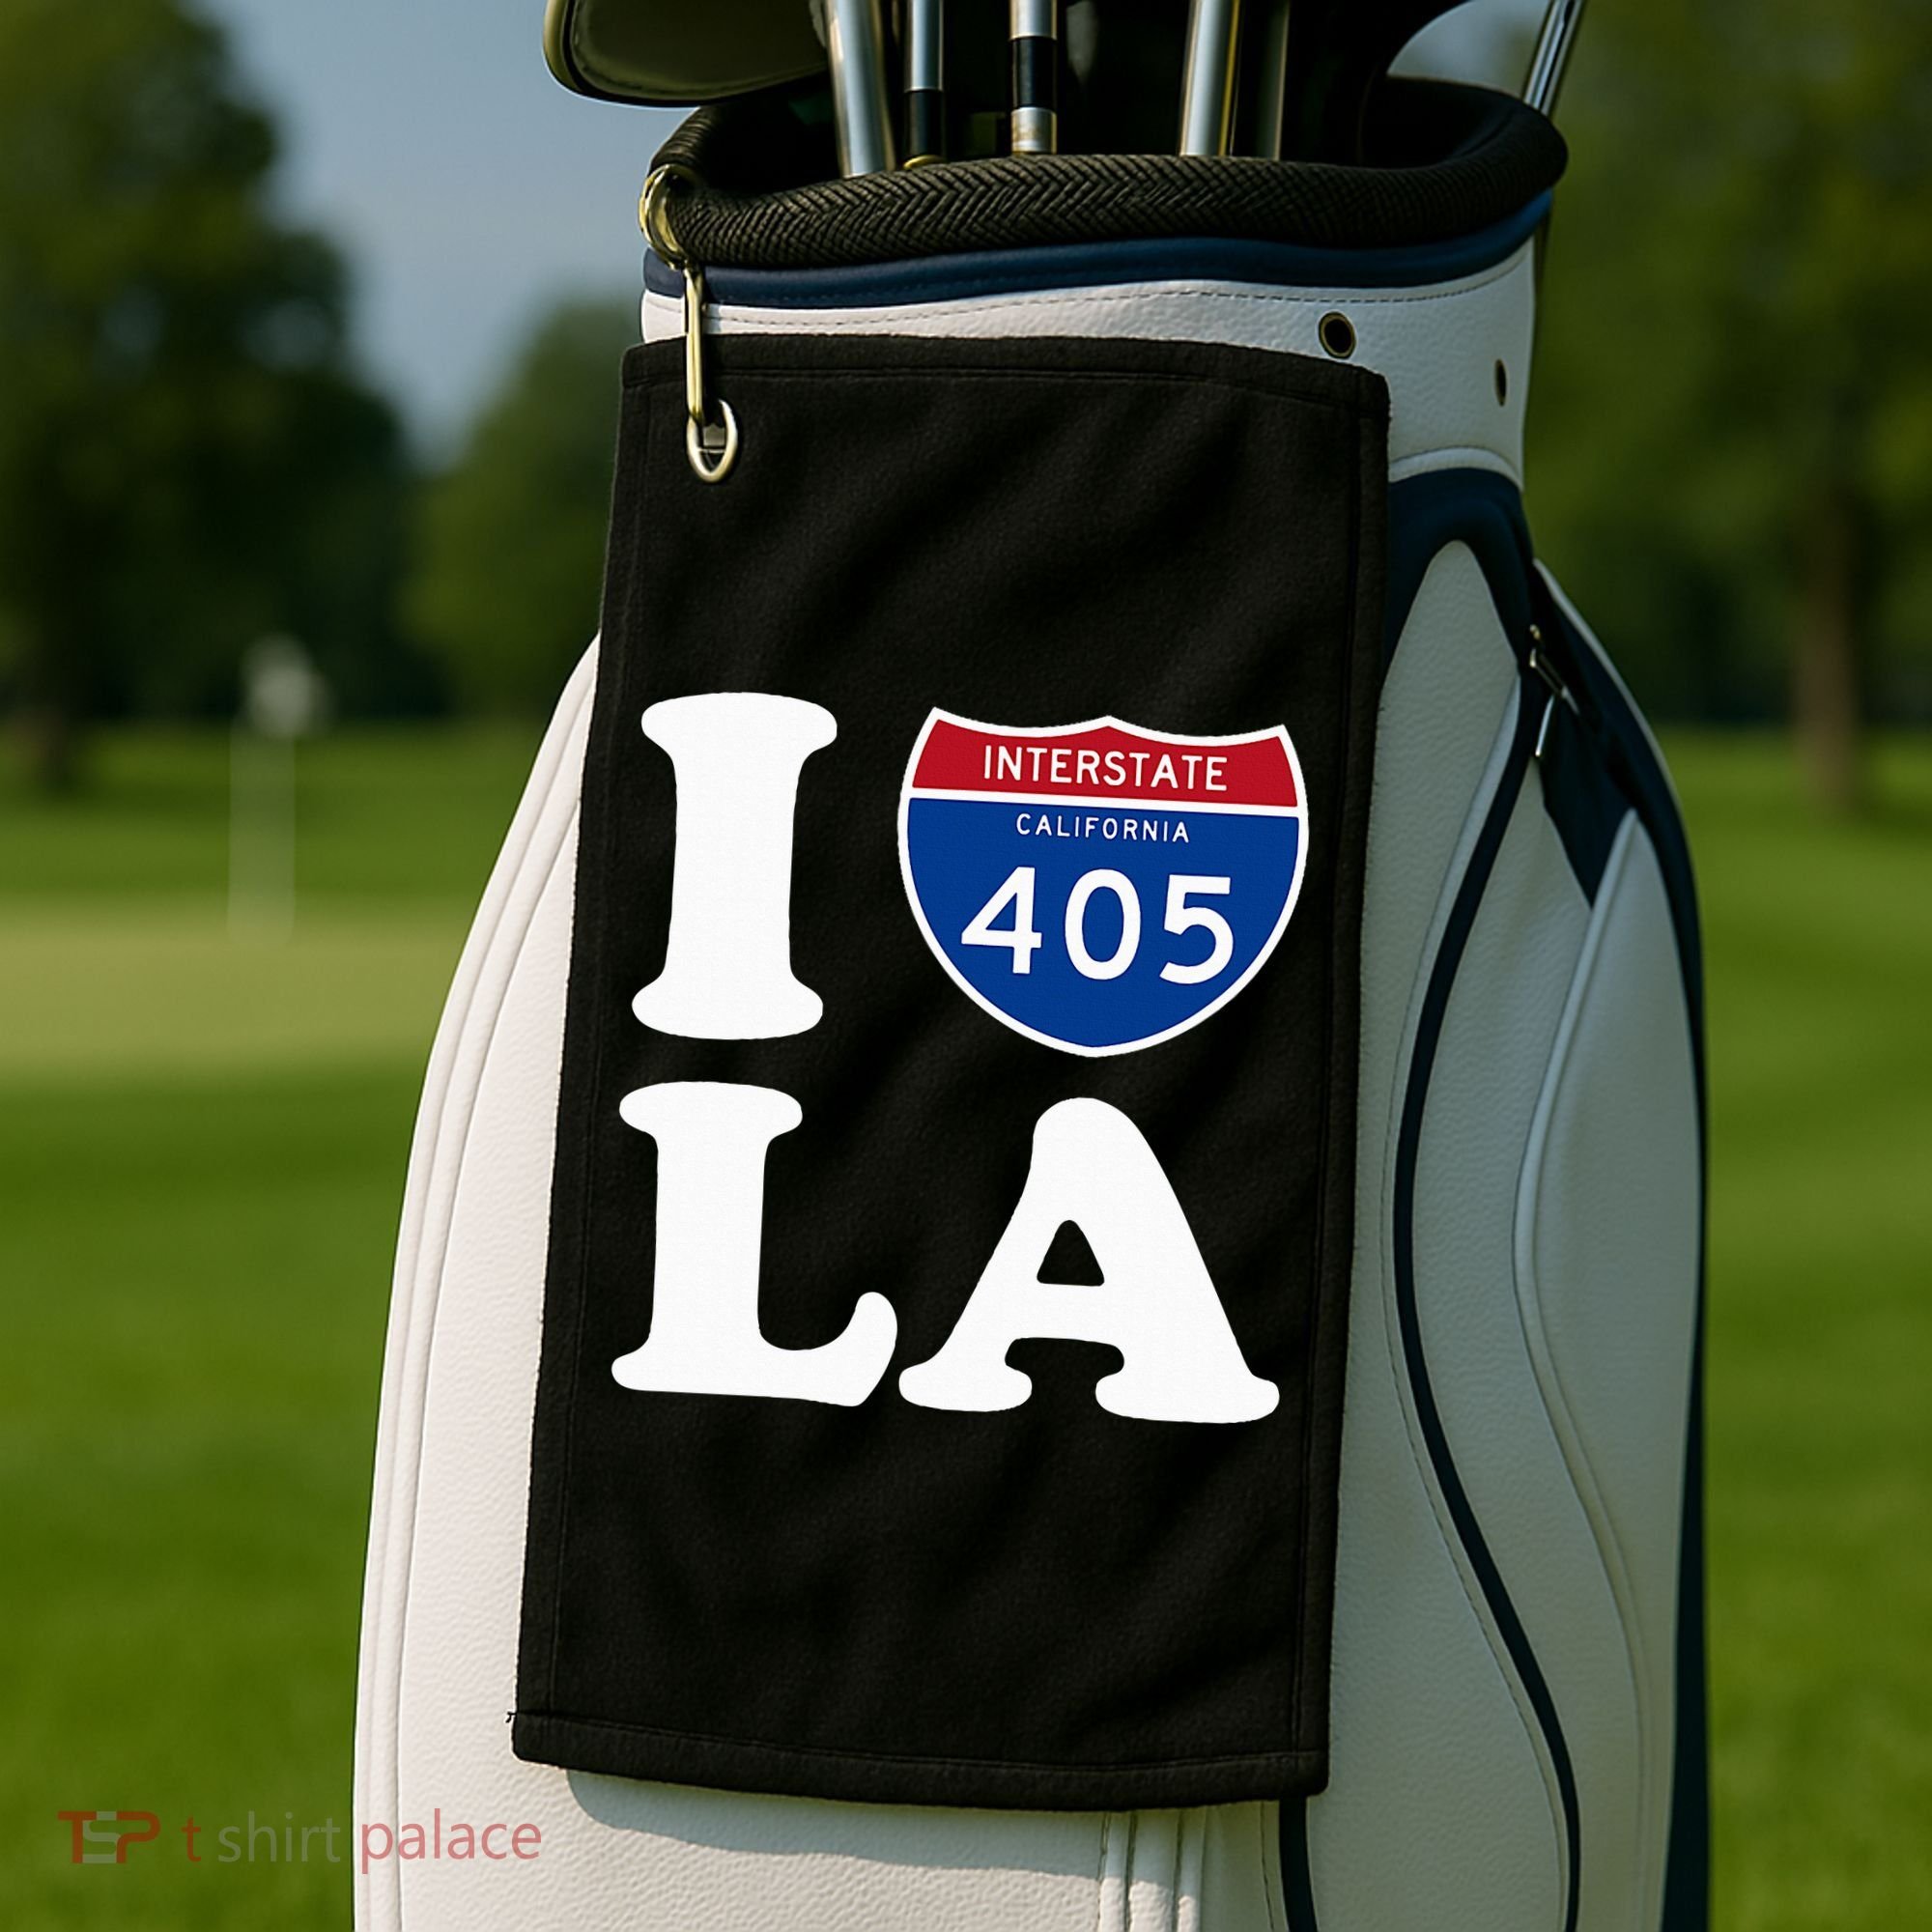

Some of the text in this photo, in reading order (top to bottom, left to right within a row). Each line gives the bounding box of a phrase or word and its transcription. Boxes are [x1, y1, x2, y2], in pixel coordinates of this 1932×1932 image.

[983, 744, 1229, 792] INTERSTATE
[632, 692, 838, 1040] I
[1015, 813, 1190, 843] CALIFORNIA
[960, 866, 1235, 985] 405
[611, 1081, 1280, 1424] LA
